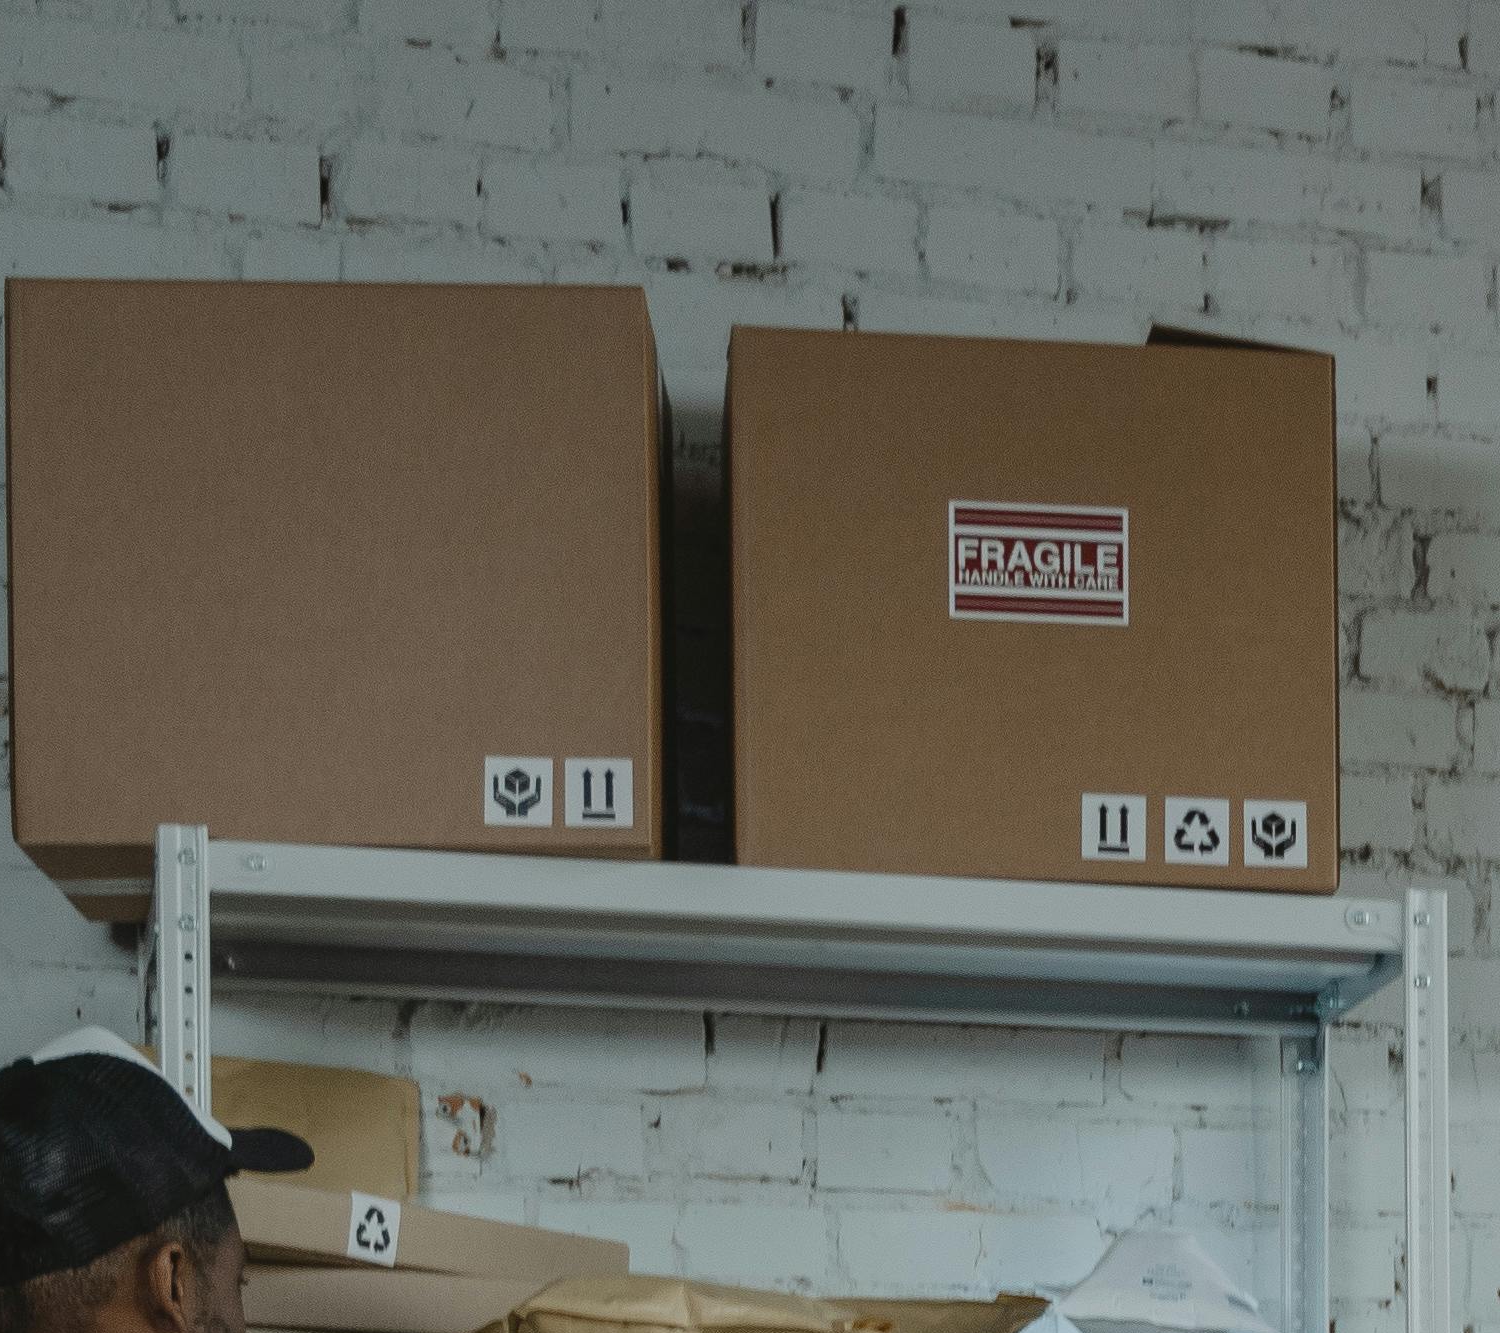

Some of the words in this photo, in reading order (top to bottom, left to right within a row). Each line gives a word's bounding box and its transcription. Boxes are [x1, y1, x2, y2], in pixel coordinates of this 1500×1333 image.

[957, 538, 1119, 576] FRAGILE
[958, 568, 1024, 588] HANDLE
[1030, 572, 1070, 590] WITH
